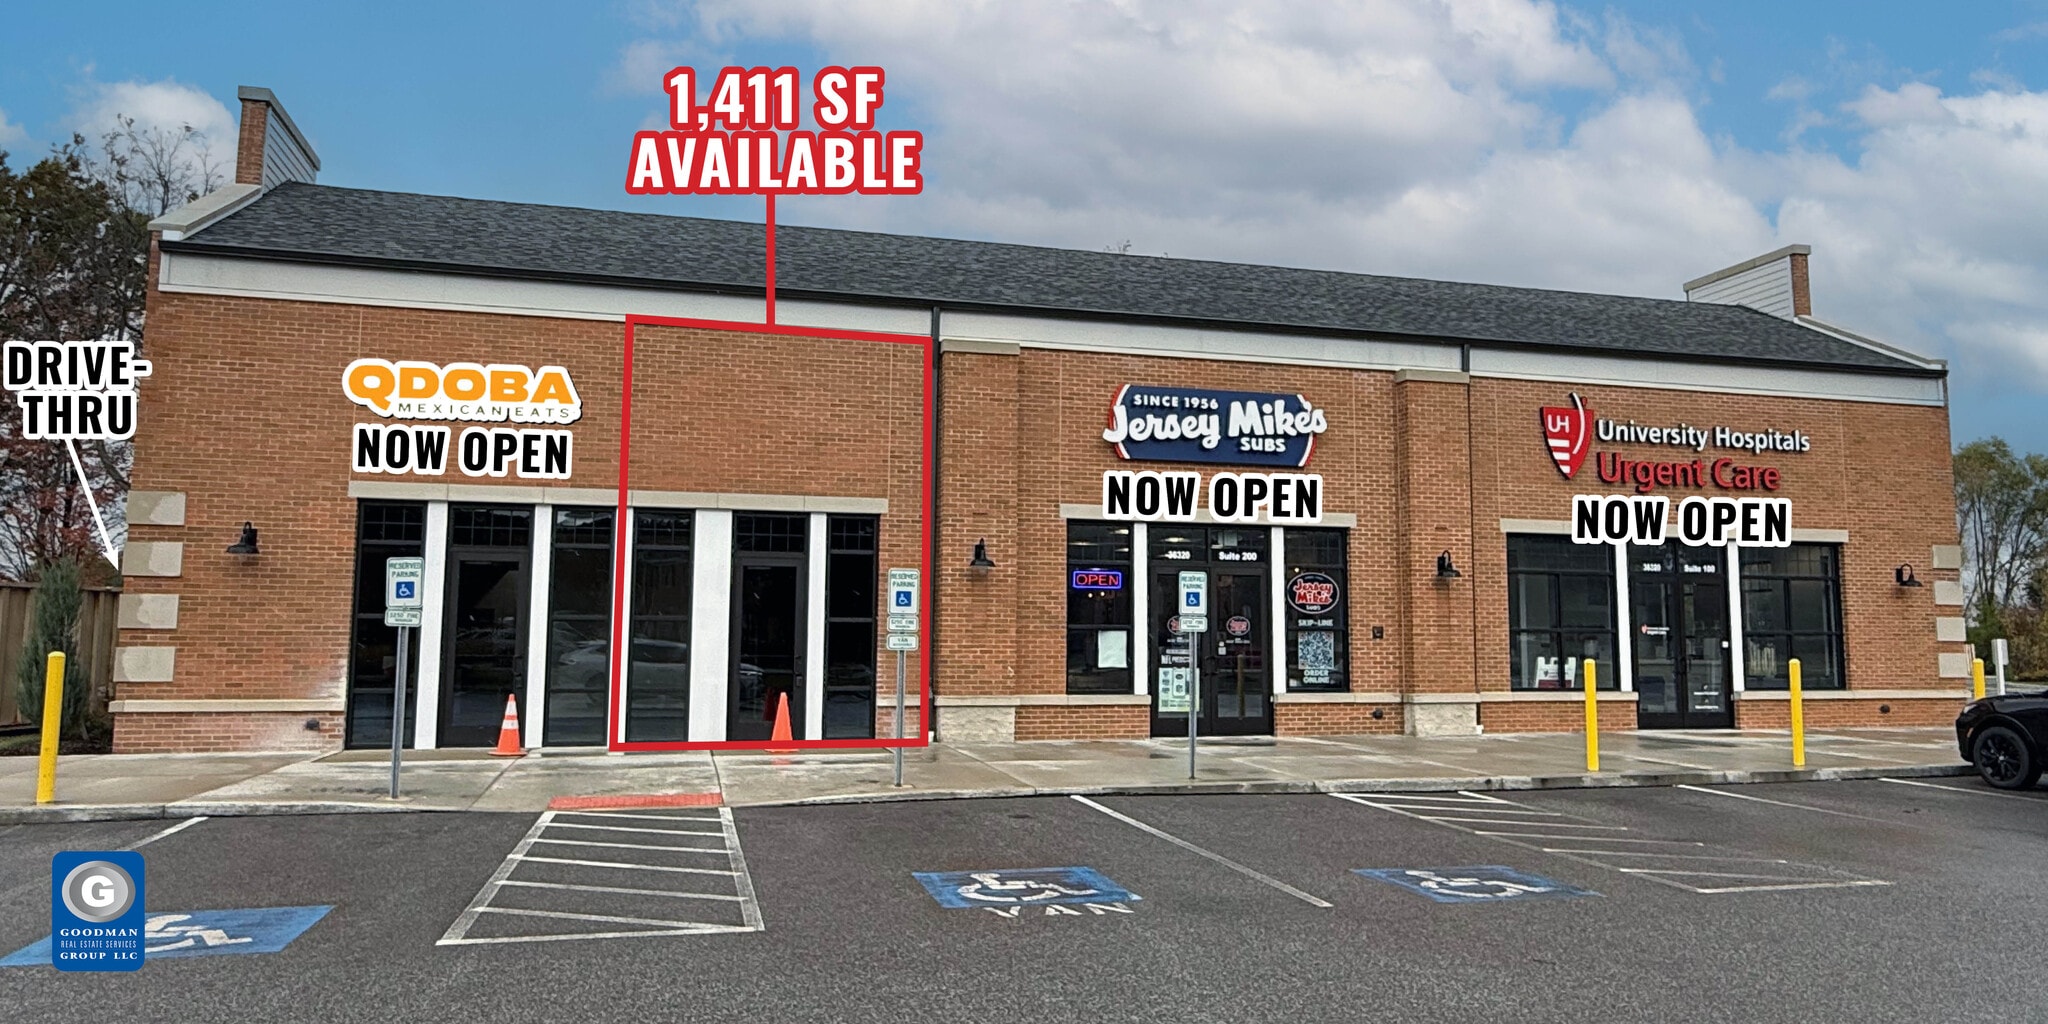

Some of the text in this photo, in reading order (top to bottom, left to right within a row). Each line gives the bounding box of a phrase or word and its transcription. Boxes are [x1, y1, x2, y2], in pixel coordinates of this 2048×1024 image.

[348, 364, 574, 411] QDOBA
[1132, 394, 1219, 410] SINCE 1956
[398, 402, 569, 418] MEXICAN EATS
[1102, 399, 1328, 450] Jersey Mike's
[1547, 413, 1570, 433] UH
[1598, 419, 1811, 454] University Hospitals
[1240, 437, 1287, 452] SUBS
[1598, 451, 1782, 493] Urgent Care
[1218, 551, 1258, 561] Suite 200
[391, 570, 420, 578] PARKING
[1076, 573, 1120, 586] OPEN
[892, 580, 916, 588] PARKING
[1293, 578, 1334, 593] Jersey
[1303, 669, 1330, 677] ORDER
[1303, 676, 1330, 684] ONLINE
[983, 902, 1135, 918] VAN
